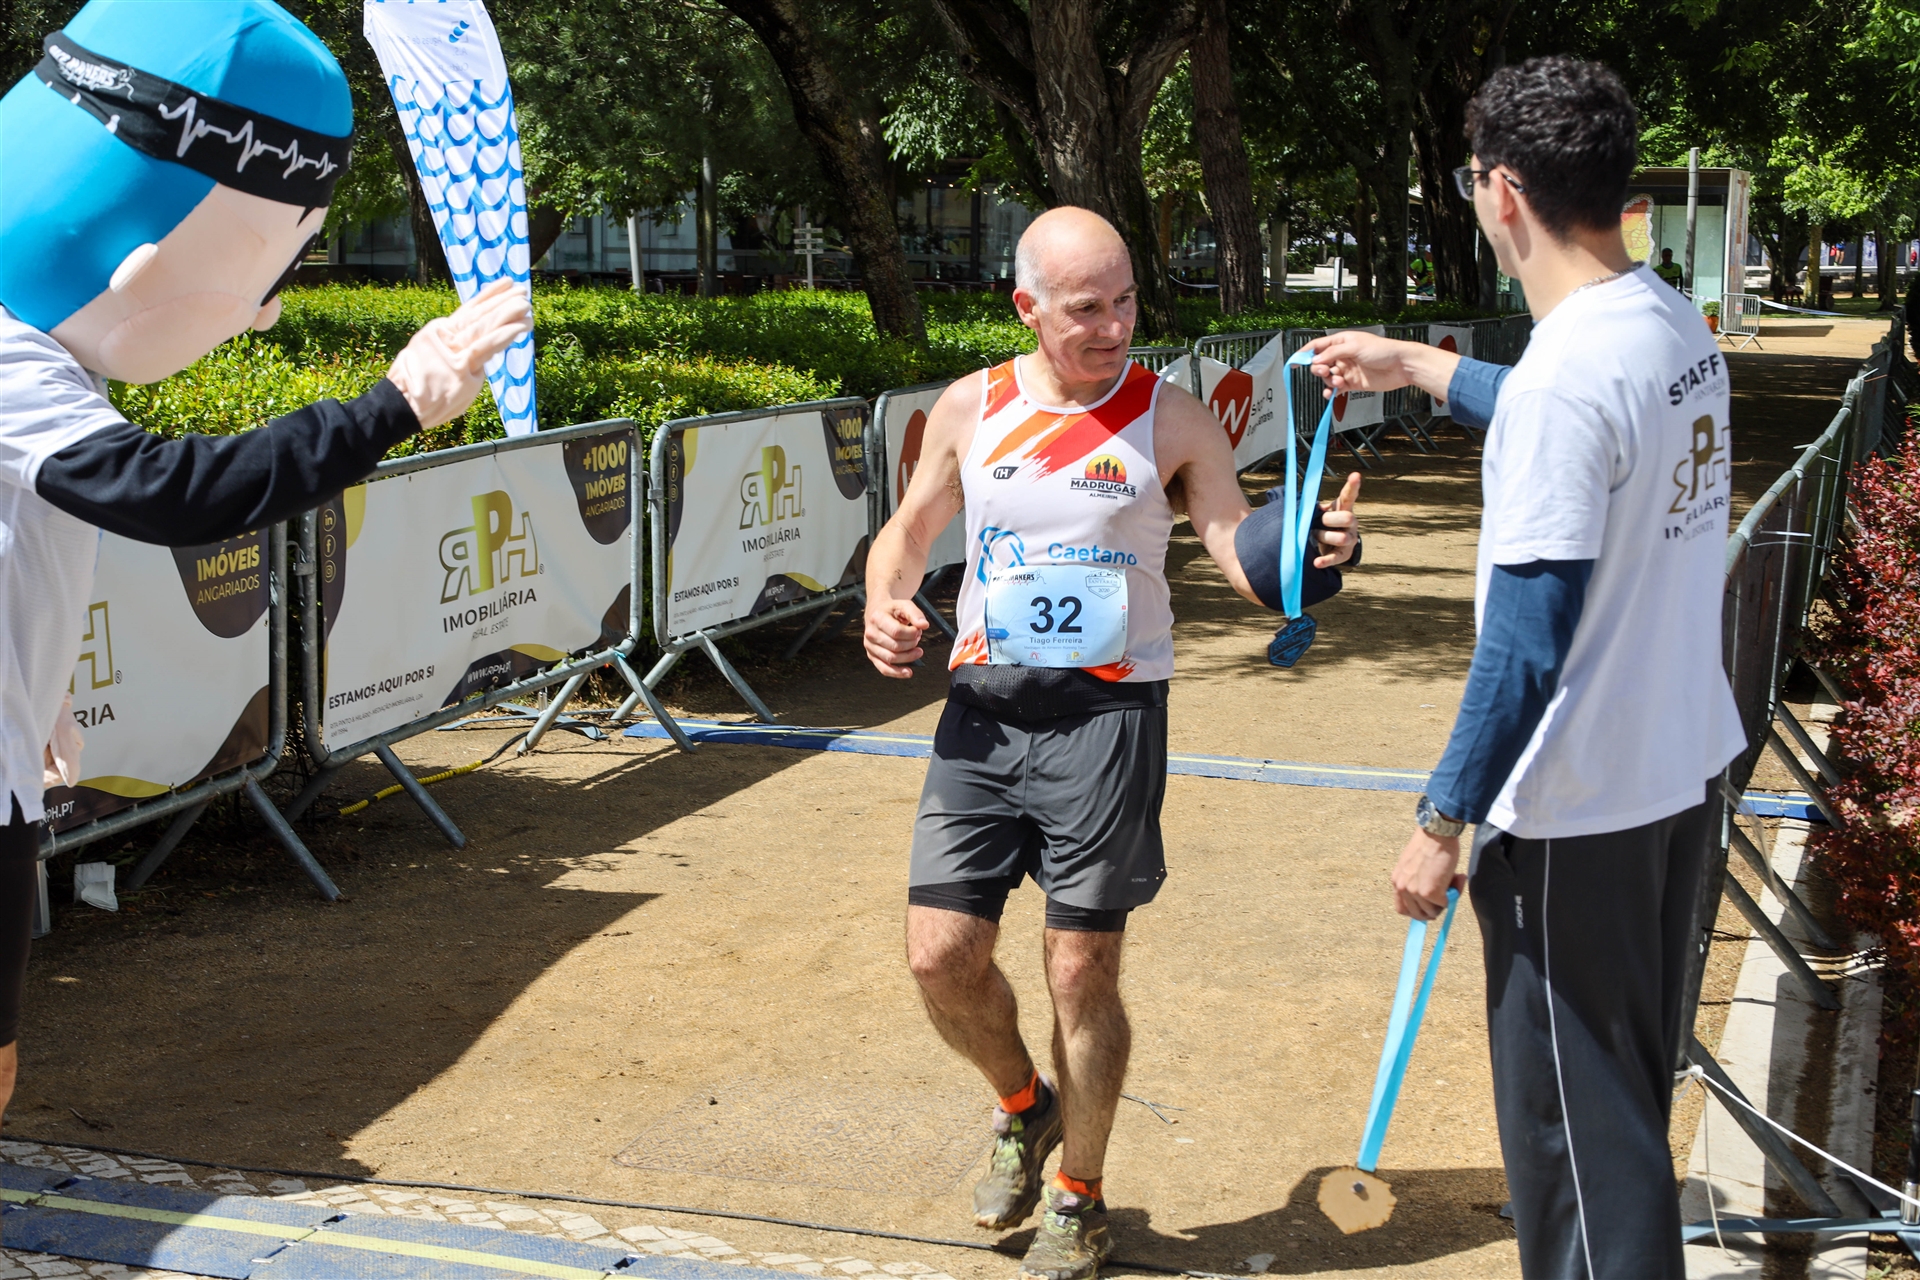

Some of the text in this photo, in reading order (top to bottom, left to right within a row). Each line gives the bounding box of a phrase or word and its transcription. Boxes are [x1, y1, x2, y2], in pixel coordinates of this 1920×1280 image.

[1668, 353, 1720, 406] STAFF
[583, 440, 627, 472] +1000
[584, 473, 626, 500] IMÓVEIS
[1070, 480, 1137, 496] MADRUGAS
[1089, 492, 1118, 500] ALMEIRIM
[584, 495, 626, 518] ANGARIADOS
[742, 527, 801, 553] IMOBILIÁRIA
[196, 544, 260, 582] IMÓVEIS
[1047, 542, 1137, 566] Caetano
[196, 573, 260, 606] ANGARIADOS
[674, 576, 740, 603] ESTAMOS AQUI POR SI
[443, 587, 537, 633] IMOBILIÁRIA
[1029, 595, 1083, 634] 32
[1029, 636, 1083, 645] Tiago Ferreira
[328, 664, 435, 710] ESTAMOS AQUI POR SI
